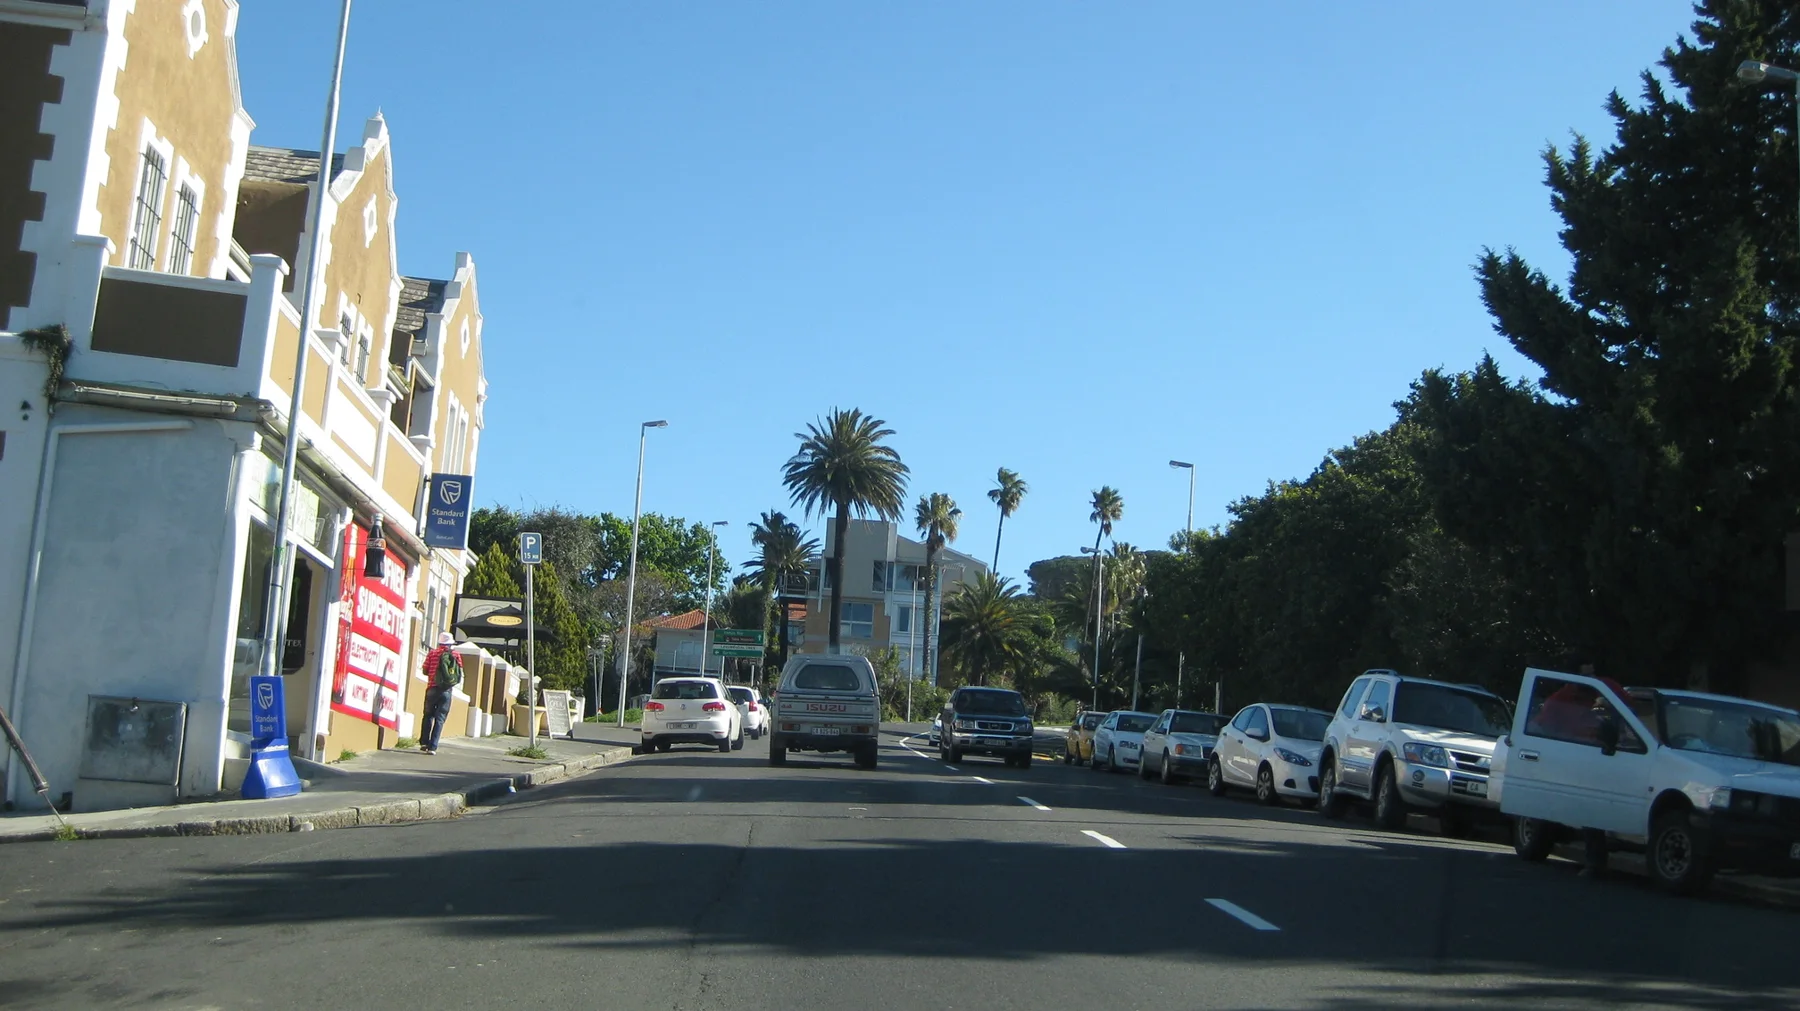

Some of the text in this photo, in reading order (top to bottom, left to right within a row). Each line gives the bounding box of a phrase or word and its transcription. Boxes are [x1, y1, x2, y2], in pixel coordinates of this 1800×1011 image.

[432, 508, 464, 517] Standard
[526, 536, 536, 549] P
[357, 585, 405, 640] SUPERETTE
[806, 703, 846, 712] ISUZU
[255, 715, 278, 723] Standard
[260, 725, 274, 733] Bank
[1470, 783, 1478, 791] CA
